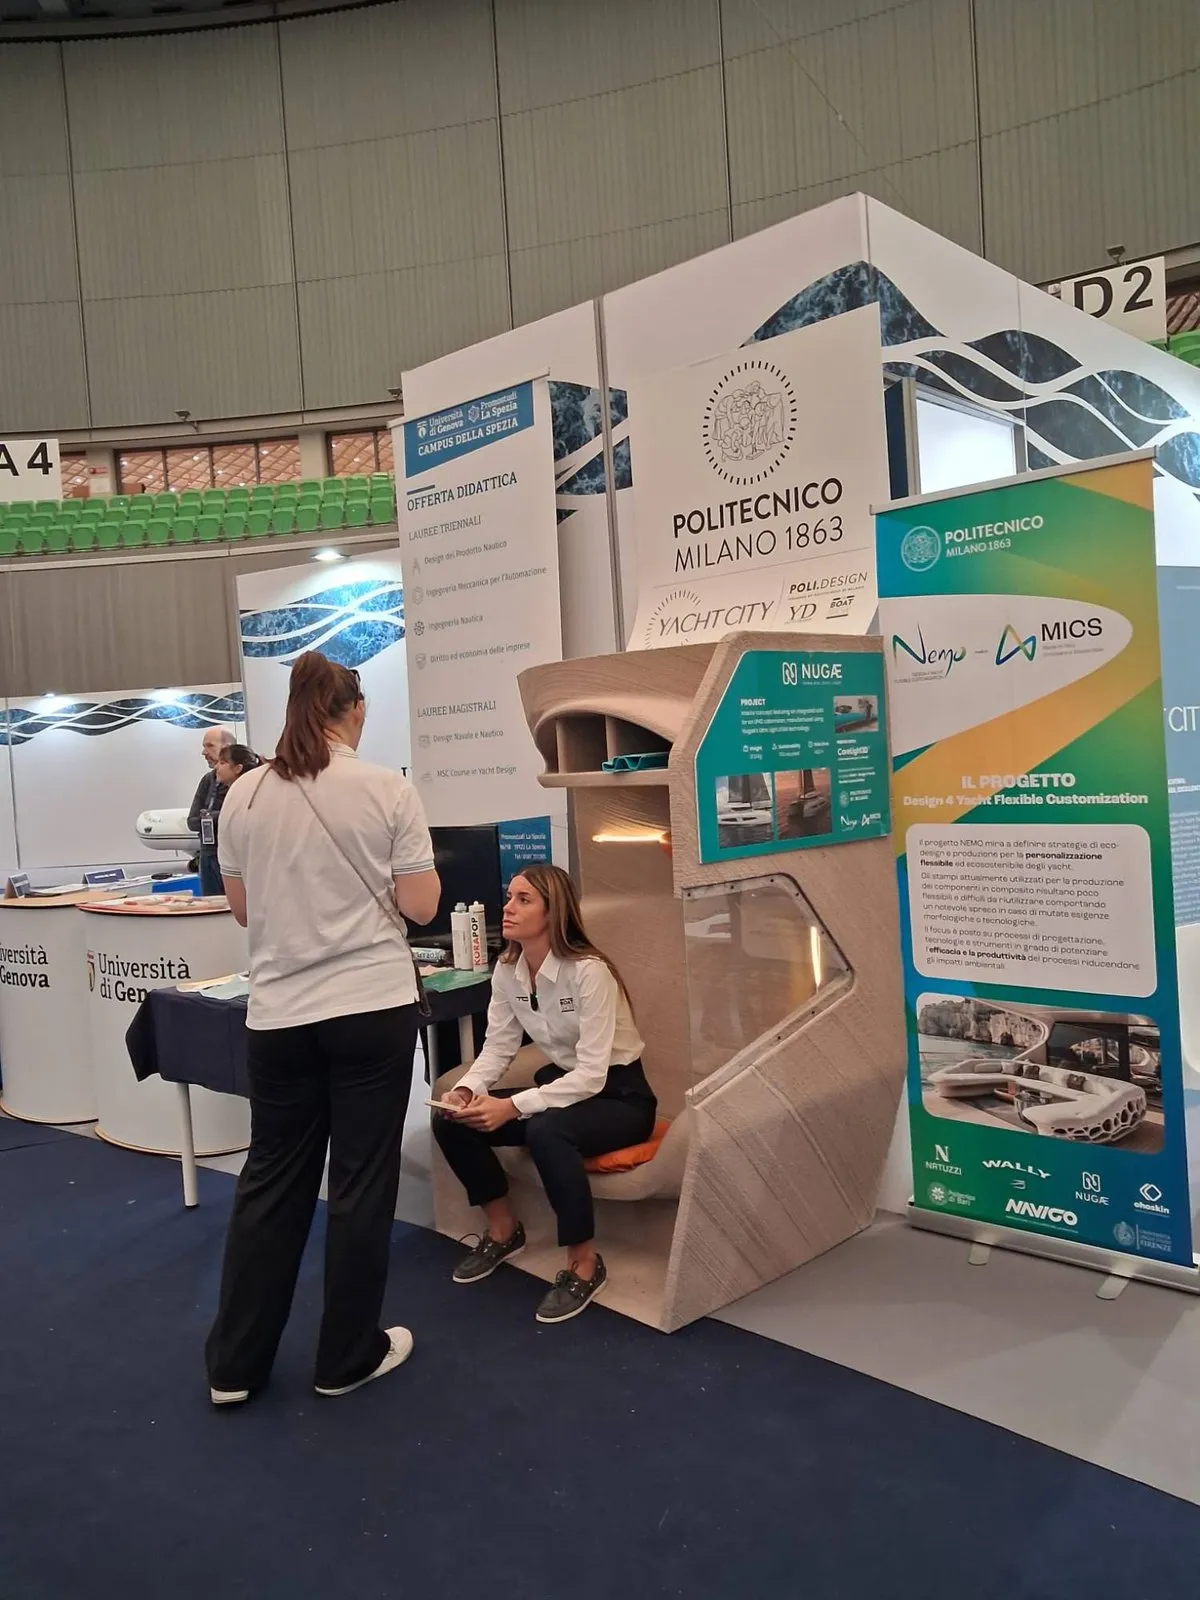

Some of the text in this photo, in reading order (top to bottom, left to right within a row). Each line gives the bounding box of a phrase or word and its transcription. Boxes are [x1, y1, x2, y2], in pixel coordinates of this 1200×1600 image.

[429, 408, 464, 428] Università
[481, 401, 518, 420] La Spezia
[418, 417, 519, 457] CAMPUS DELLA SPEZIA
[429, 419, 464, 437] di Genova
[407, 471, 518, 512] OFFERTA DIDATTICA
[673, 477, 843, 539] POLITECNICO
[408, 515, 482, 542] LAUREE TRIENNALI
[945, 515, 1044, 544] POLITECNICO
[674, 515, 845, 573] MILANO 1863
[945, 538, 1012, 558] MILANO 1863
[789, 572, 868, 594] POLI.DESIGN
[790, 603, 817, 621] YD
[1041, 617, 1103, 642] MICS
[892, 624, 967, 678] Nemo
[417, 700, 497, 718] LAUREE MAGISTRALI
[962, 773, 1077, 789] IL PROGETTO
[903, 792, 1149, 809] Design 4 Yacht Flexible Customization
[924, 840, 959, 849] progetto
[960, 839, 985, 847] NEMO
[1013, 840, 1047, 848] definire
[1048, 841, 1089, 851] strategie
[1090, 841, 1099, 849] di
[920, 850, 945, 858] design
[952, 851, 998, 860] produzione
[999, 851, 1016, 860] per
[1025, 851, 1103, 861] personalizzazione
[920, 860, 1046, 872] flessibile ed ecosostenibile degli
[932, 873, 959, 881] stampi
[959, 874, 1009, 883] attualmente
[1009, 876, 1044, 884] utilizzati
[1045, 877, 1061, 885] per
[1062, 877, 1071, 885] la
[1072, 878, 1125, 887] produzione
[921, 882, 933, 890] dei
[934, 884, 981, 893] componenti
[990, 886, 1035, 895] composito
[1036, 887, 1075, 896] risultano
[1076, 890, 1100, 898] poco
[922, 892, 953, 901] flessibili
[960, 894, 986, 902] difficili
[987, 895, 998, 903] da
[998, 896, 1044, 906] riutilizzare
[1045, 899, 1107, 909] comportando
[923, 913, 975, 923] morfologiche
[934, 903, 968, 912] notevole
[968, 906, 997, 914] spreco
[1007, 908, 1028, 916] caso
[1029, 908, 1037, 916] di
[1038, 910, 1069, 918] mutate
[1070, 911, 1110, 921] esigenze
[470, 917, 482, 966] KORAPOP
[930, 926, 951, 935] focus
[959, 928, 982, 937] posto
[994, 931, 1031, 940] processi
[925, 936, 965, 947] tecnologie
[972, 940, 1013, 950] strumenti
[1023, 944, 1050, 953] grado
[1051, 945, 1059, 953] di
[1060, 946, 1109, 957] potenziare
[97, 952, 192, 980] Università
[926, 956, 936, 965] gli
[936, 957, 964, 966] impatti
[968, 949, 976, 957] la
[976, 950, 1027, 961] produttività
[1042, 956, 1080, 966] processi
[1081, 958, 1141, 970] riducendone
[99, 978, 112, 1000] di
[925, 1161, 962, 1176] NATUZZI
[981, 1159, 1052, 1180] WALLY
[1075, 1190, 1110, 1206] NUGÆ
[1005, 1198, 1079, 1226] NAVIGO
